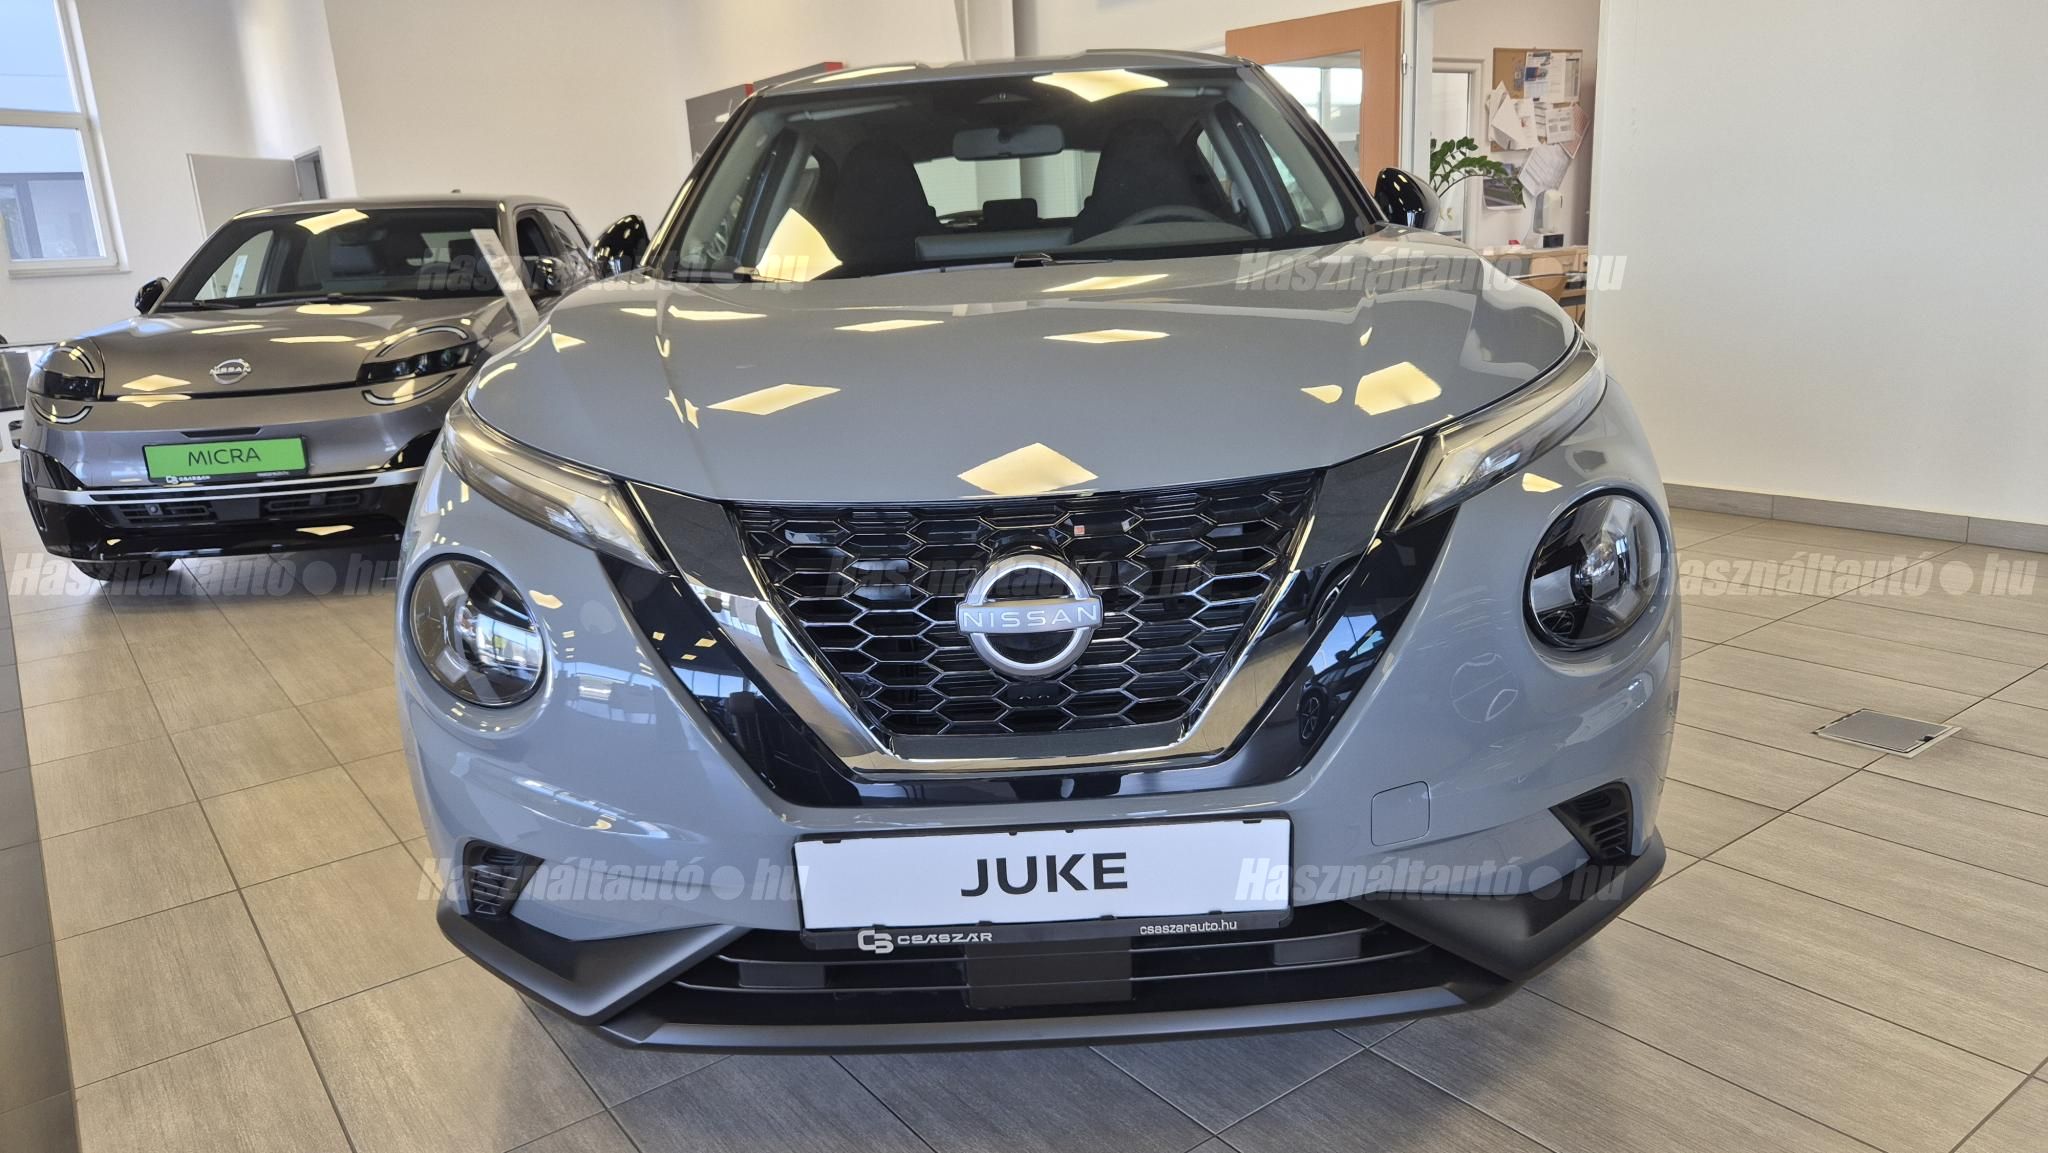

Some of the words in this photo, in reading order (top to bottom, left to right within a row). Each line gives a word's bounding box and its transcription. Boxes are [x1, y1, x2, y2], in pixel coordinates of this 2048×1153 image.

[188, 447, 262, 467] MICRA
[963, 605, 1098, 628] NISSAN
[961, 852, 1128, 897] JUKE
[1140, 919, 1238, 935] csaszarauto.hu
